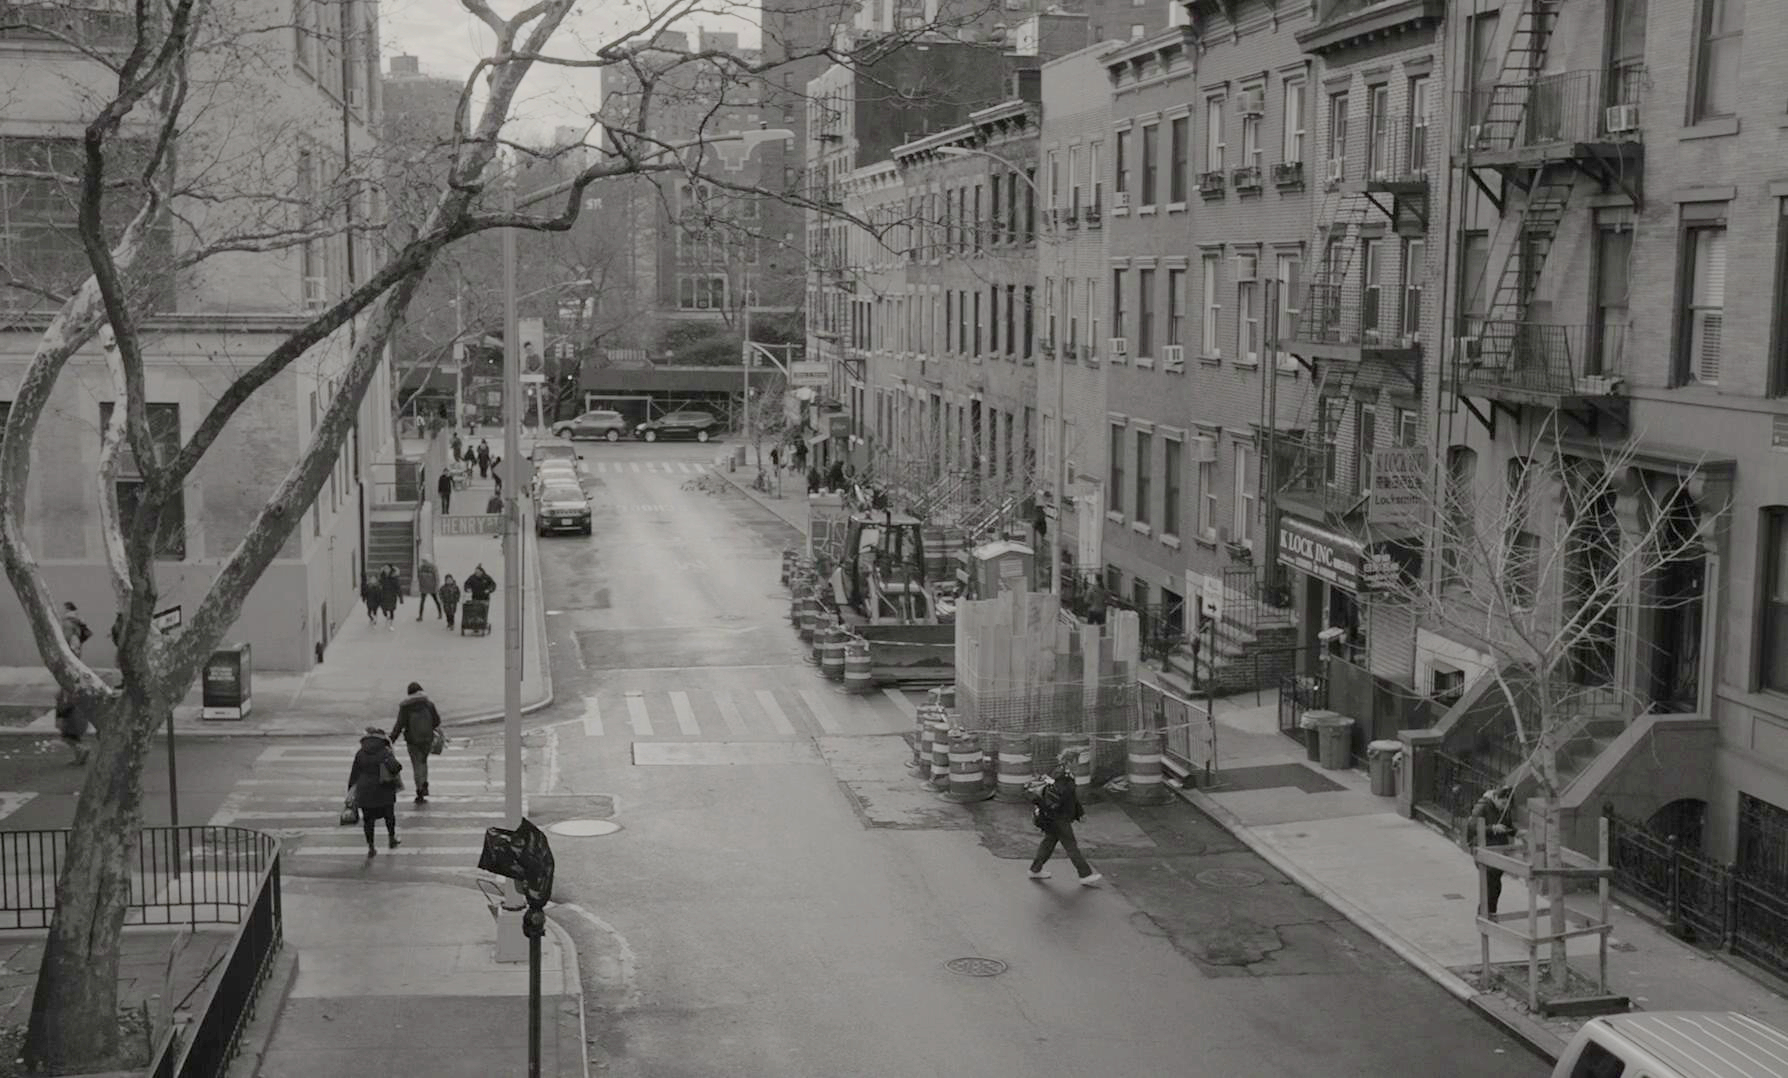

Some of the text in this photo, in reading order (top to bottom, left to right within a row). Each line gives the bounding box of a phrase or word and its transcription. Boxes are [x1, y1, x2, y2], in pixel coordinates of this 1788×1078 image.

[442, 517, 484, 534] HENRY
[1280, 528, 1288, 548] K
[1288, 532, 1314, 559] LOCK
[1315, 543, 1334, 567] INC
